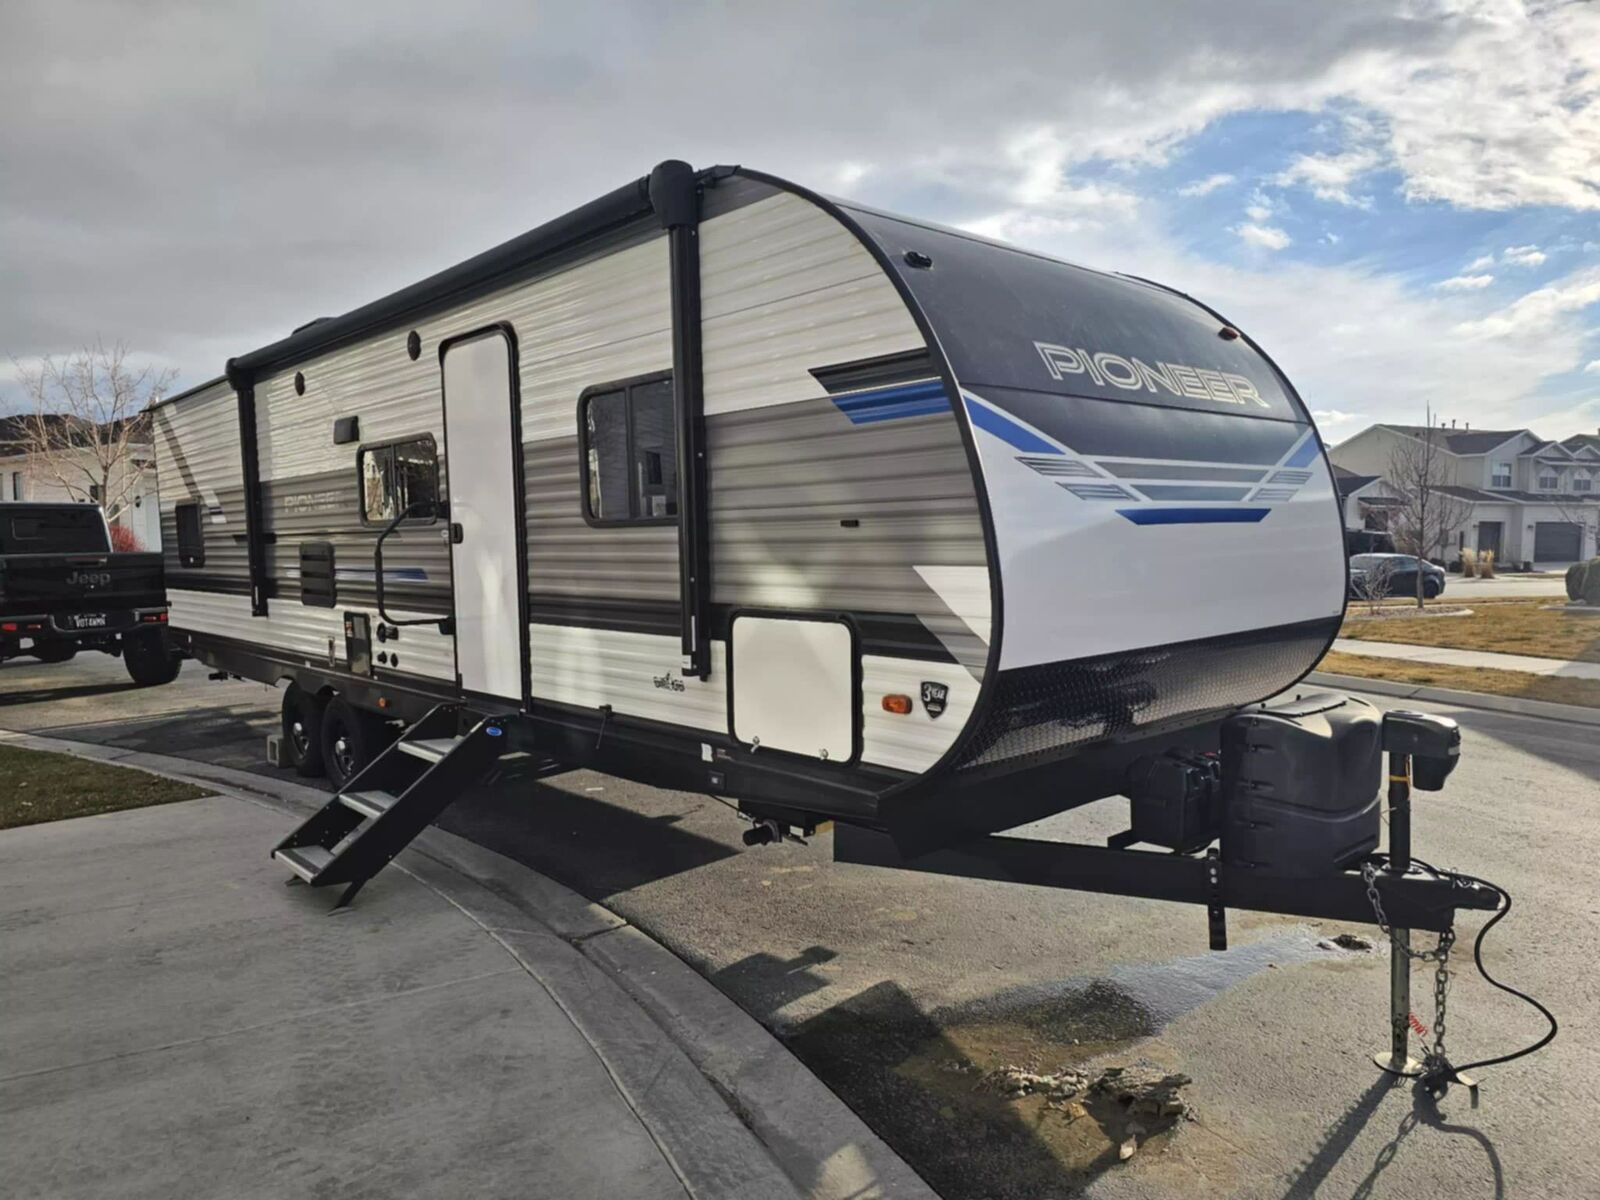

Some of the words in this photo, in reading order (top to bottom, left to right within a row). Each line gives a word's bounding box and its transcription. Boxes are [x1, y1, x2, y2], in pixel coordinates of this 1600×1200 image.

[1033, 341, 1270, 409] PIONEER
[66, 571, 111, 585] Jeep
[923, 684, 931, 702] 3
